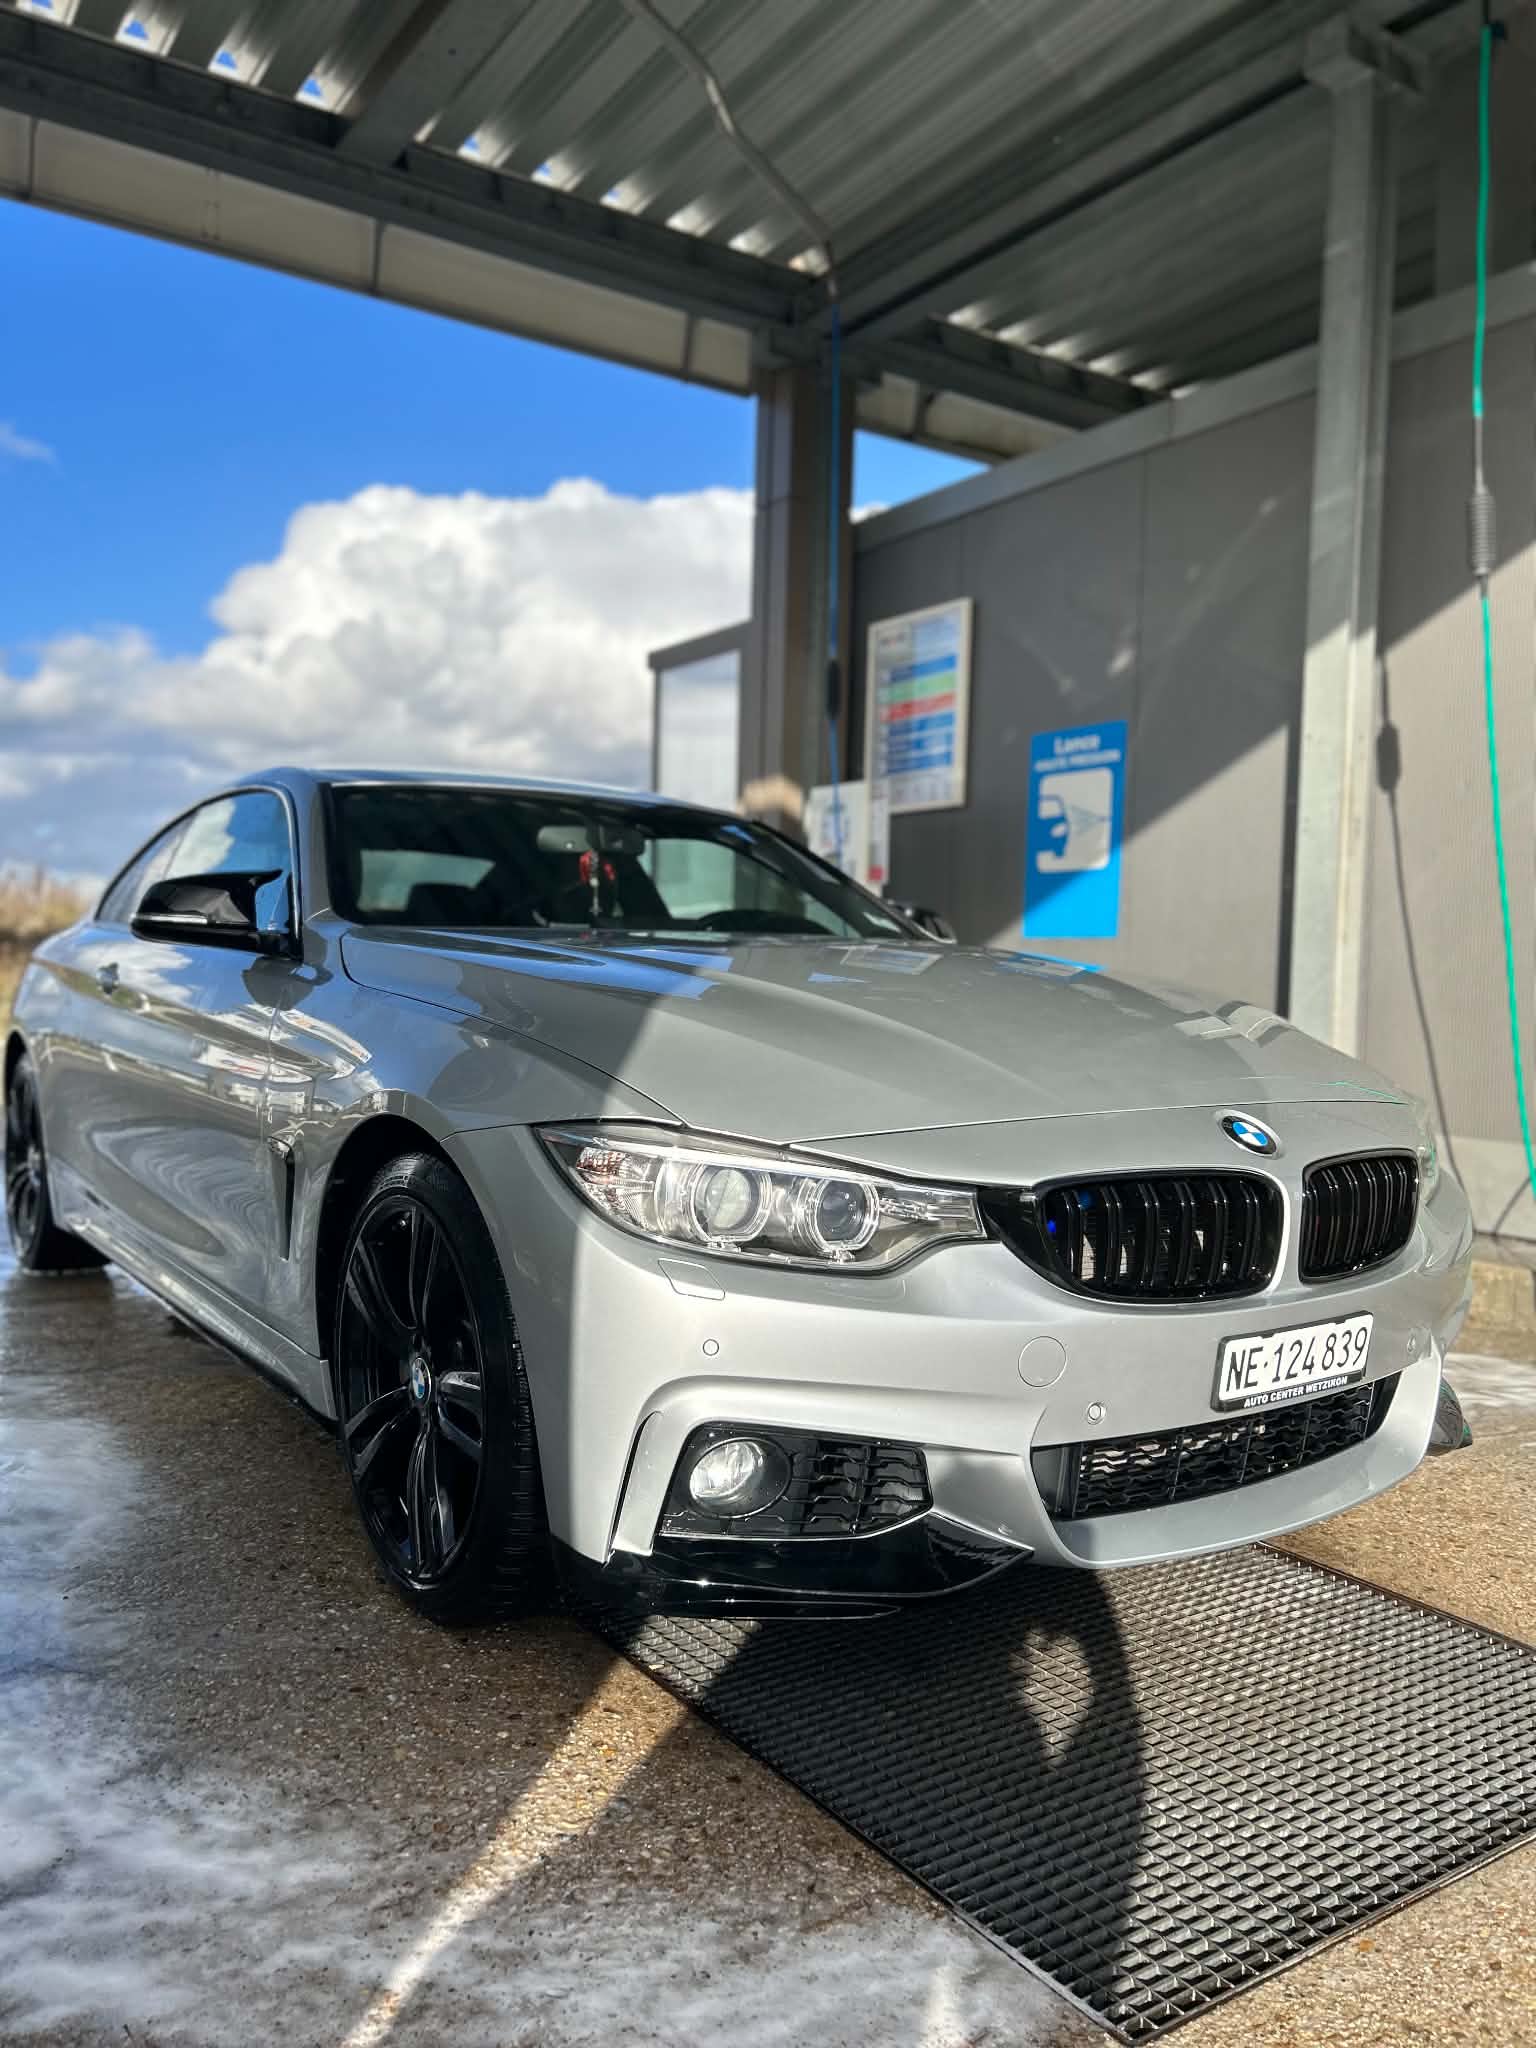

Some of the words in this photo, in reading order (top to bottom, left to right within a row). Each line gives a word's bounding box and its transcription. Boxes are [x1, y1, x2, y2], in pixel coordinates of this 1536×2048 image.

[1244, 1395, 1269, 1408] AUTO
[1270, 1387, 1304, 1401] CENTER
[1305, 1376, 1348, 1394] WETZIKON
